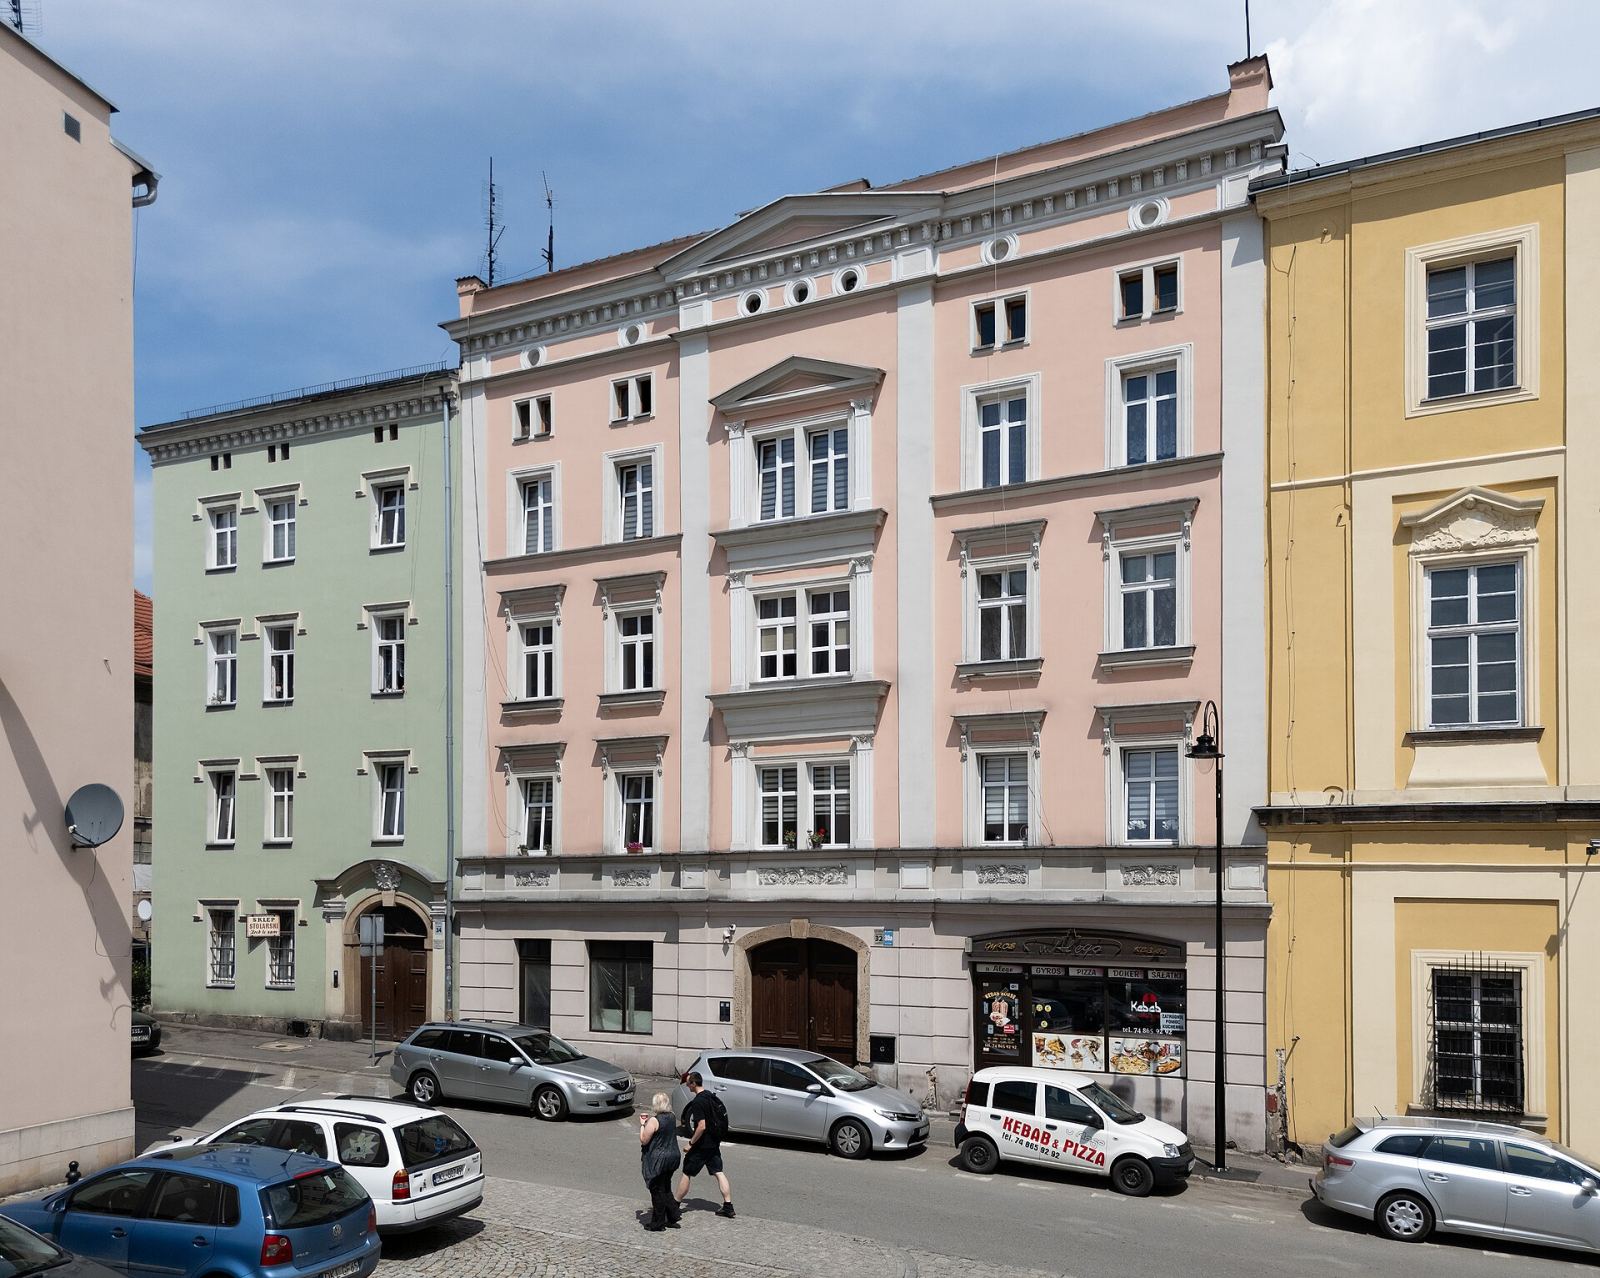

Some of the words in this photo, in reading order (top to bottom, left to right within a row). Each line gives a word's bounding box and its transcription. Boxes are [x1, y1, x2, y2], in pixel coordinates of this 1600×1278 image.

[1035, 967, 1062, 975] GYROS
[1076, 968, 1097, 976] PIZZA
[1130, 1000, 1162, 1013] Kebab
[1142, 1027, 1154, 1035] 865
[1001, 1132, 1013, 1142] tel.
[1014, 1136, 1024, 1145] 74
[1024, 1140, 1039, 1151] 865
[1040, 1146, 1049, 1156] 92
[1050, 1150, 1061, 1160] 92
[1002, 1116, 1052, 1146] KEBAB
[1051, 1139, 1059, 1150] &
[1062, 1139, 1106, 1167] PIZZA
